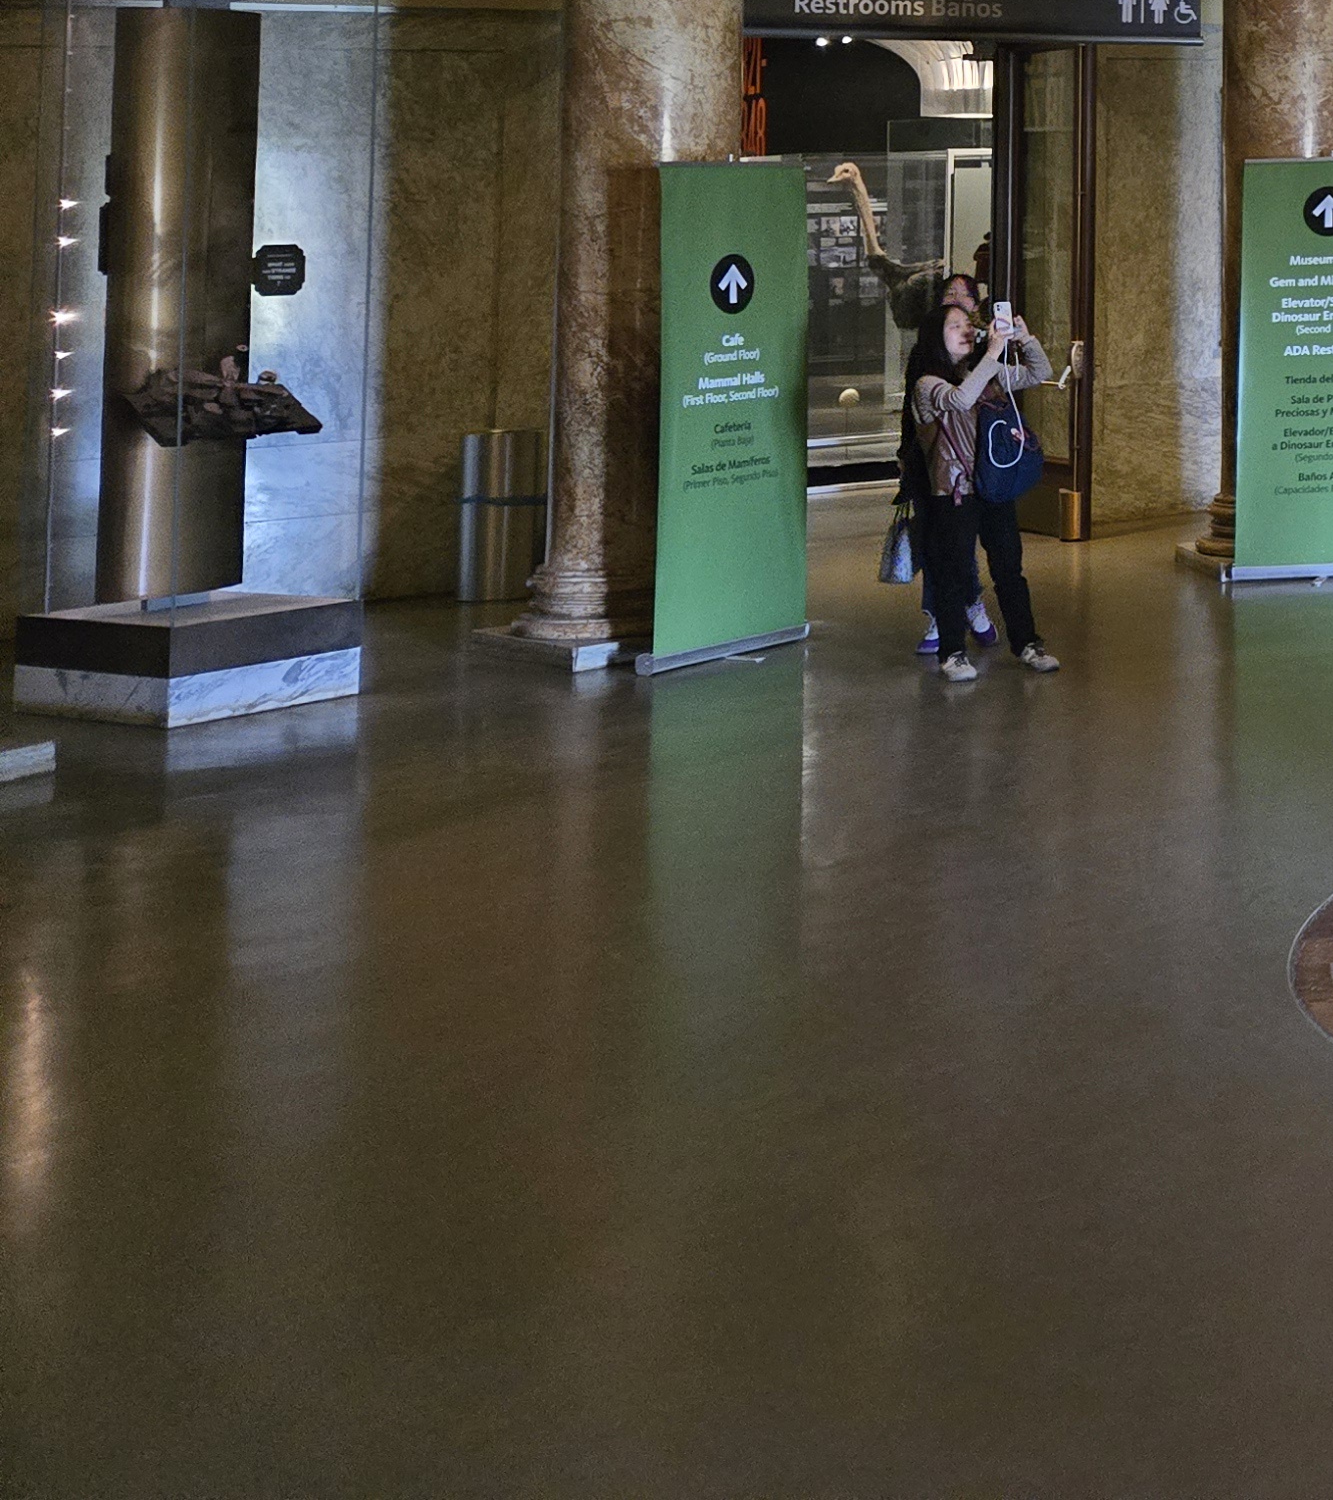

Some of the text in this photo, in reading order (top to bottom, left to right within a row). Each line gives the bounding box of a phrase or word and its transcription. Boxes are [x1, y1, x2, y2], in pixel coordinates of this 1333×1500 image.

[1269, 277, 1296, 288] Gem
[1297, 275, 1318, 287] and
[1271, 312, 1321, 323] Dinosaur
[1295, 323, 1331, 336] (Second
[721, 333, 745, 347] Cafe
[738, 347, 760, 361] Floor)
[1283, 345, 1310, 356] ADA
[698, 371, 765, 390] Mammal Halls
[1285, 374, 1318, 385] Tienda
[729, 388, 756, 401] Second
[757, 385, 779, 398] Floor)
[1290, 395, 1311, 405] Sala
[1312, 394, 1325, 404] de
[1275, 408, 1321, 419] Preciosas
[1321, 409, 1328, 419] y
[1271, 443, 1279, 451] a
[1280, 441, 1324, 451] Dinosaur
[691, 463, 715, 476] Salas
[715, 461, 727, 472] de
[1298, 472, 1328, 482] Baños
